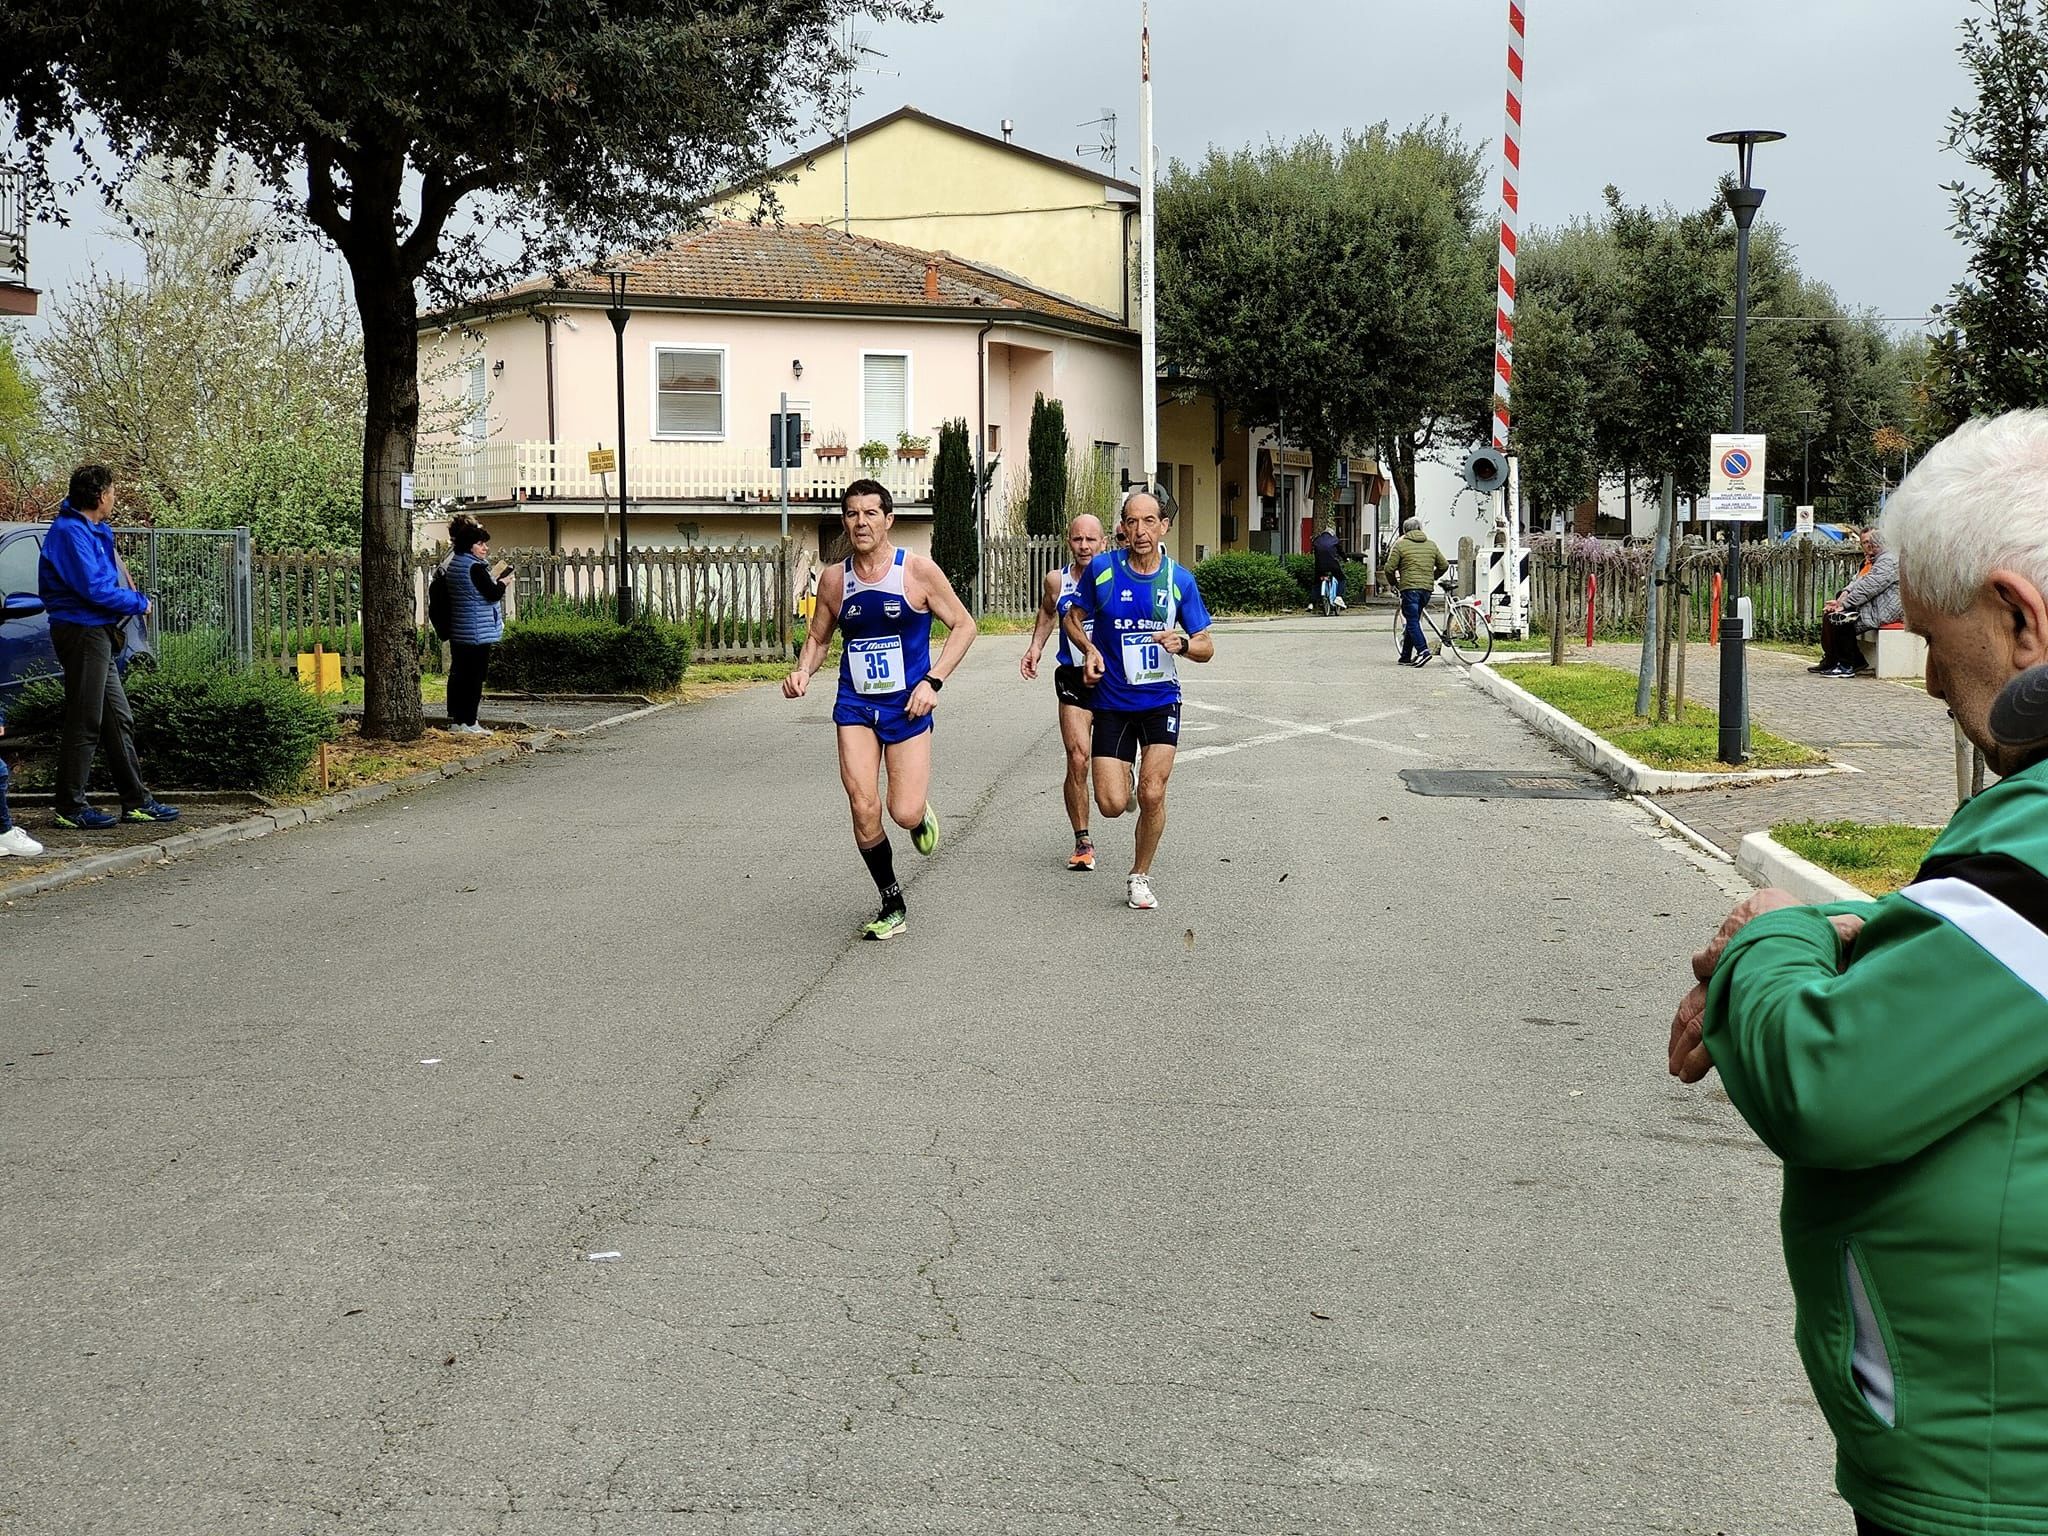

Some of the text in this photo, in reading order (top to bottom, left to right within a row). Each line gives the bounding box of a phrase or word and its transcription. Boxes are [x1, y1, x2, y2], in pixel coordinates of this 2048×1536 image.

[1276, 452, 1310, 465] TBACCHERIA
[1114, 619, 1136, 629] S.P.
[865, 652, 890, 679] 35
[1140, 645, 1158, 669] 19
